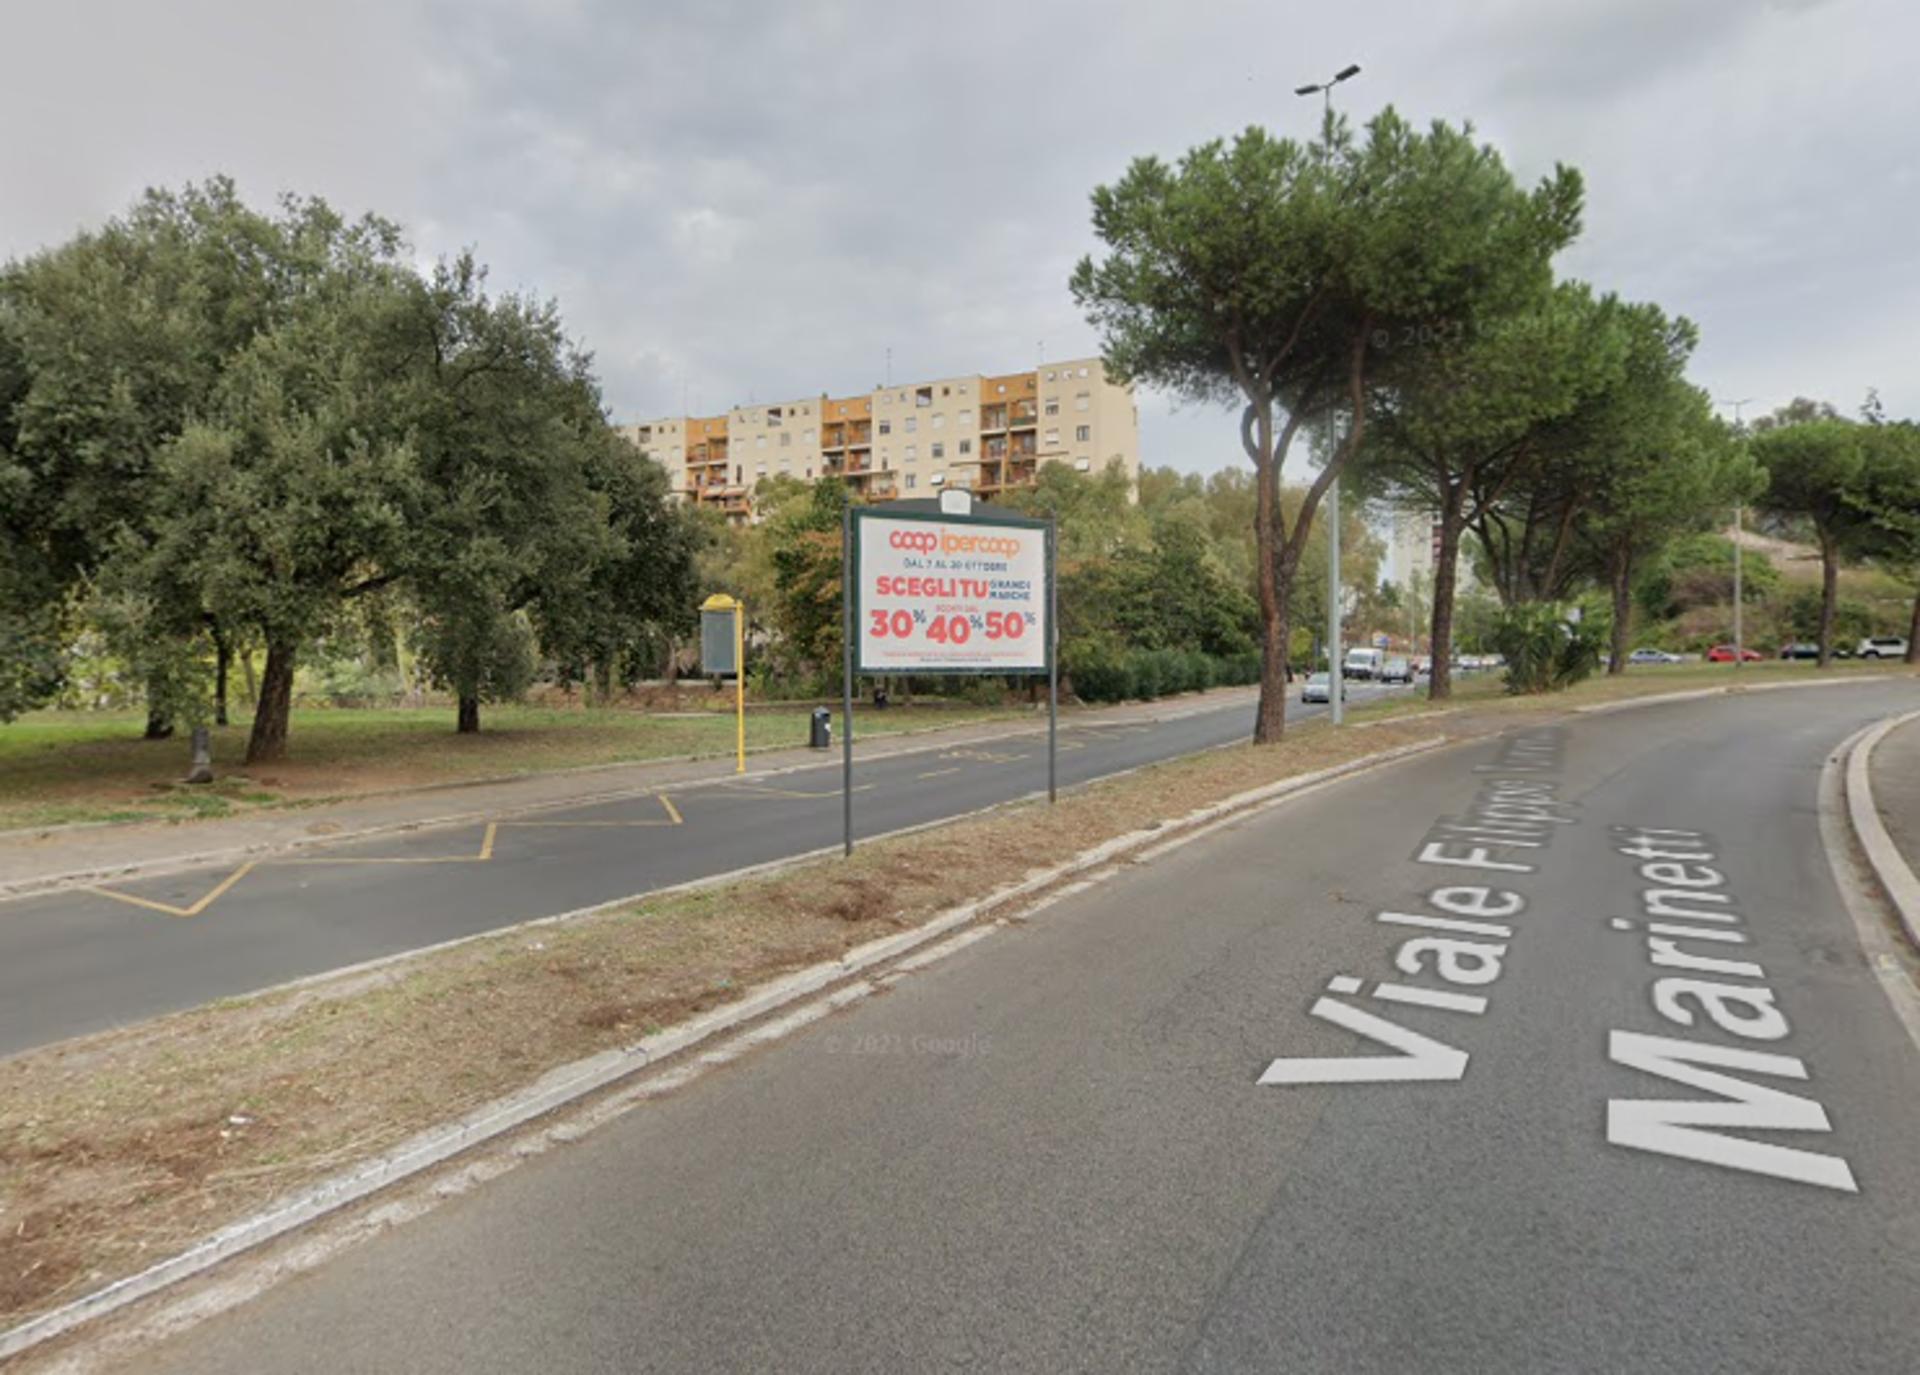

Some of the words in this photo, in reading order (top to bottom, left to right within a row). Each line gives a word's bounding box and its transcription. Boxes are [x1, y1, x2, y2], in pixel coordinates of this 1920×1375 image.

[890, 530, 938, 555] coop
[941, 528, 1020, 558] ipercoop
[903, 557, 923, 569] DAL
[876, 575, 956, 598] SCEGLI
[959, 578, 988, 599] TU
